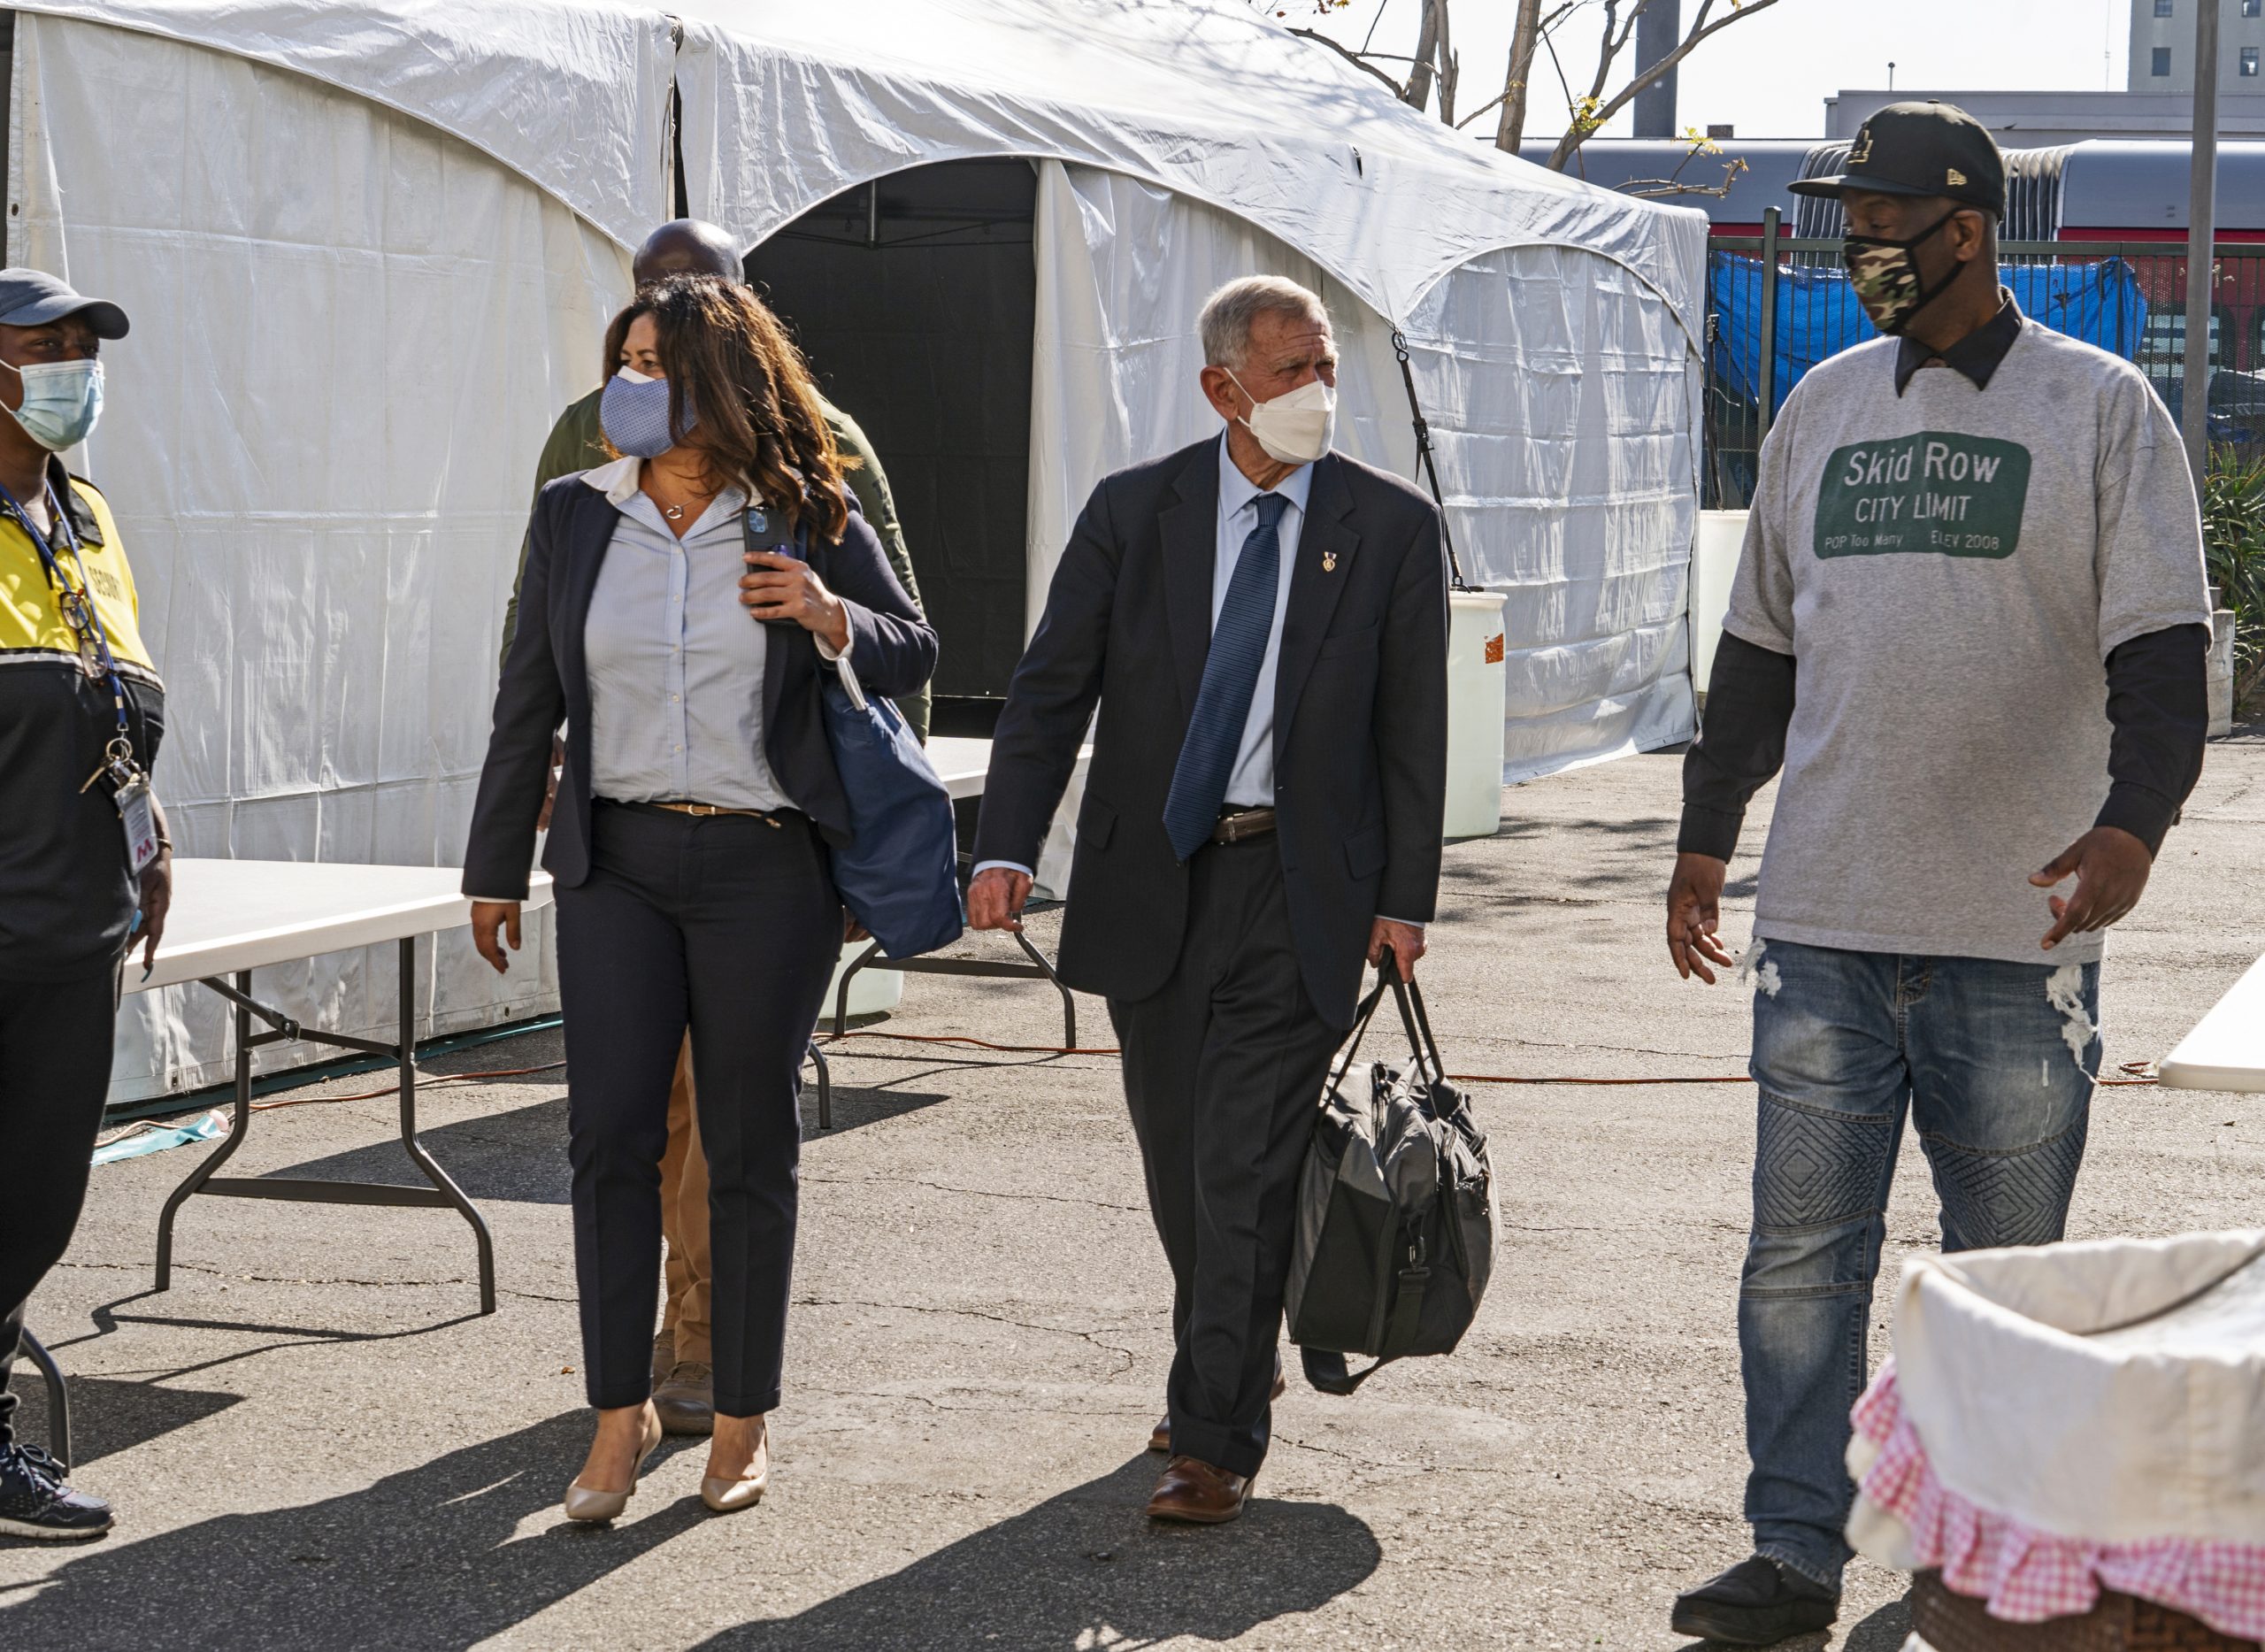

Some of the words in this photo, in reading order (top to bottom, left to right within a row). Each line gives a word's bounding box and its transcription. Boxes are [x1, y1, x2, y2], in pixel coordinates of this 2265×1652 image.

[1844, 445, 1914, 486] Skid
[1923, 441, 2001, 483] Row
[1854, 495, 1906, 523] CITY
[1913, 491, 1972, 521] LIMIT
[1824, 534, 1847, 549] POP
[1850, 534, 1870, 547] Too
[1874, 534, 1904, 548] Many
[1931, 529, 1960, 549] ELEV
[1965, 534, 2000, 550] 2008
